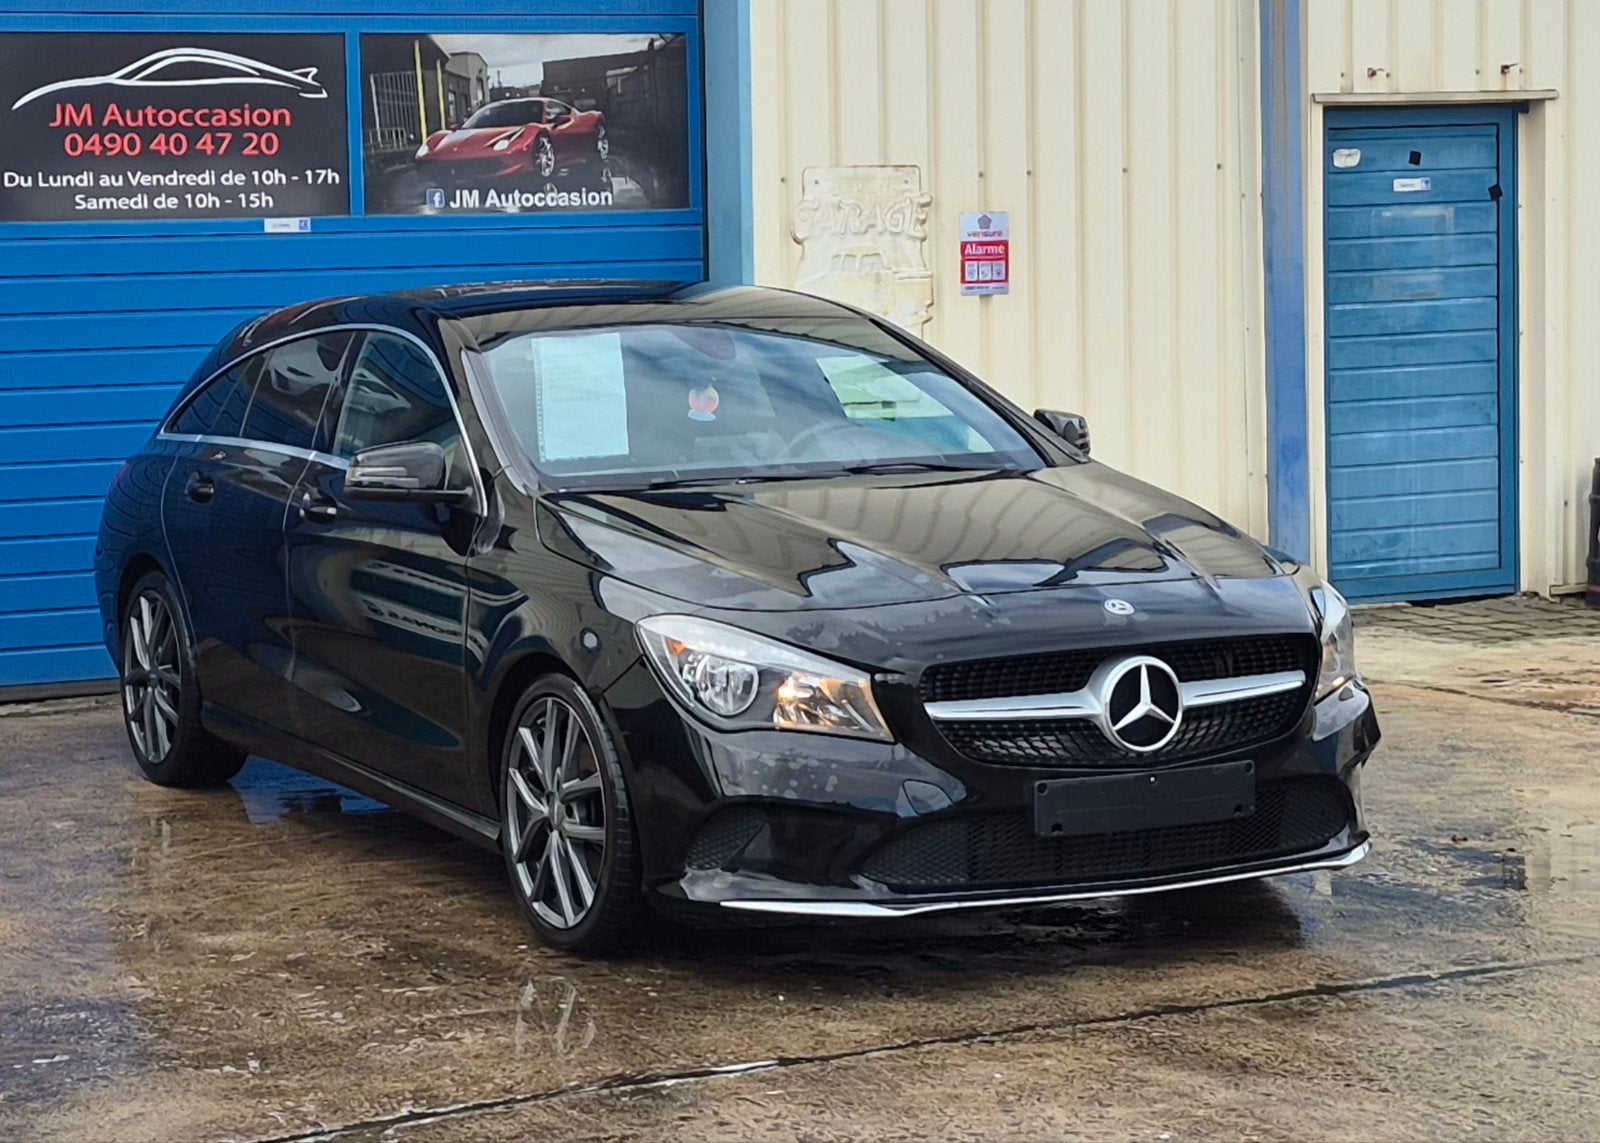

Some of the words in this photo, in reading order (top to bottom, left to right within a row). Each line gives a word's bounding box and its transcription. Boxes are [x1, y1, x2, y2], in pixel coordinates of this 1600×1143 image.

[49, 104, 94, 128] JM
[102, 104, 292, 127] Autoccasion
[64, 133, 143, 156] 0490
[150, 133, 189, 156] 40
[195, 133, 233, 155] 47
[242, 132, 280, 156] 20
[3, 172, 33, 187] Du
[37, 171, 94, 187] Lundi
[98, 175, 124, 187] au
[127, 170, 216, 187] Vendredi
[220, 170, 247, 186] de
[252, 169, 288, 186] 10h
[305, 169, 340, 185] 17h
[74, 194, 149, 210] Samedi
[152, 193, 179, 210] de
[185, 192, 221, 209] 10h
[238, 192, 274, 208] 15h
[450, 190, 479, 208] JM
[485, 188, 613, 208] Autoccasion
[965, 243, 1005, 255] Alarme
